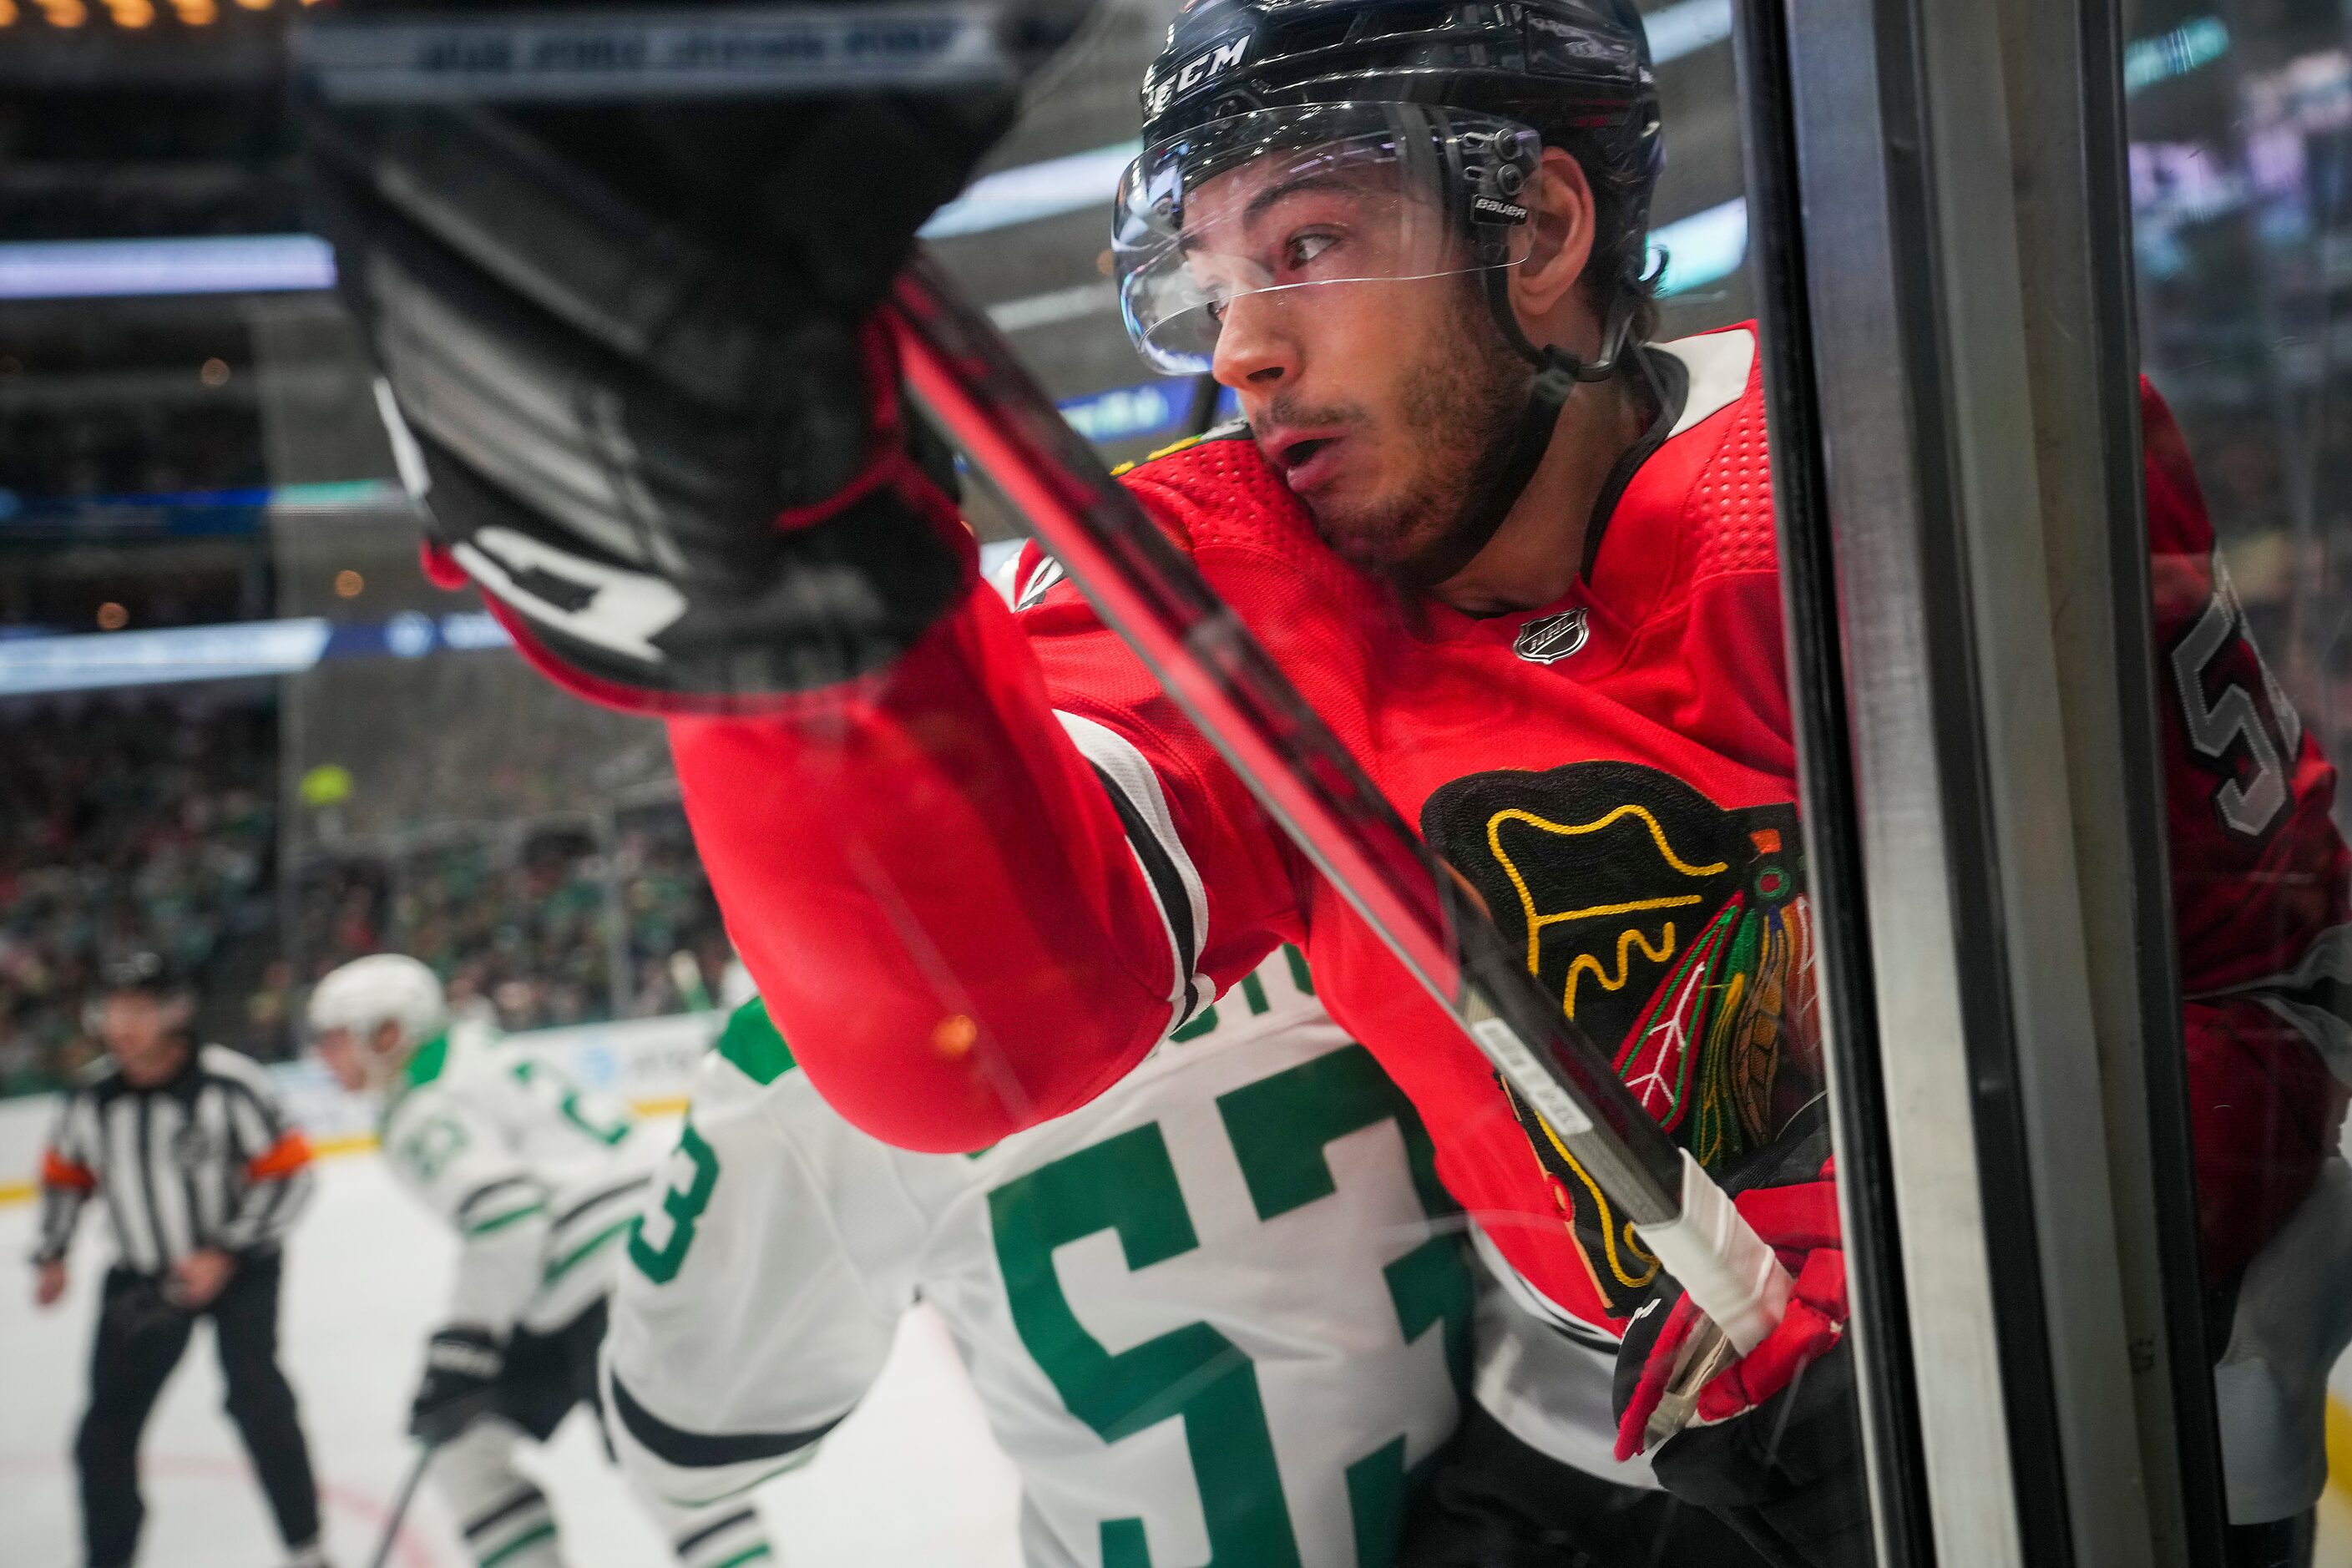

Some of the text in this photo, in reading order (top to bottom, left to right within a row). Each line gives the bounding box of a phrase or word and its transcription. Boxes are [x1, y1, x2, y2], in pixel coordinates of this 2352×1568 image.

[1475, 198, 1528, 219] BAUER
[1529, 617, 1575, 652] NHL
[988, 1044, 1474, 1568] 53
